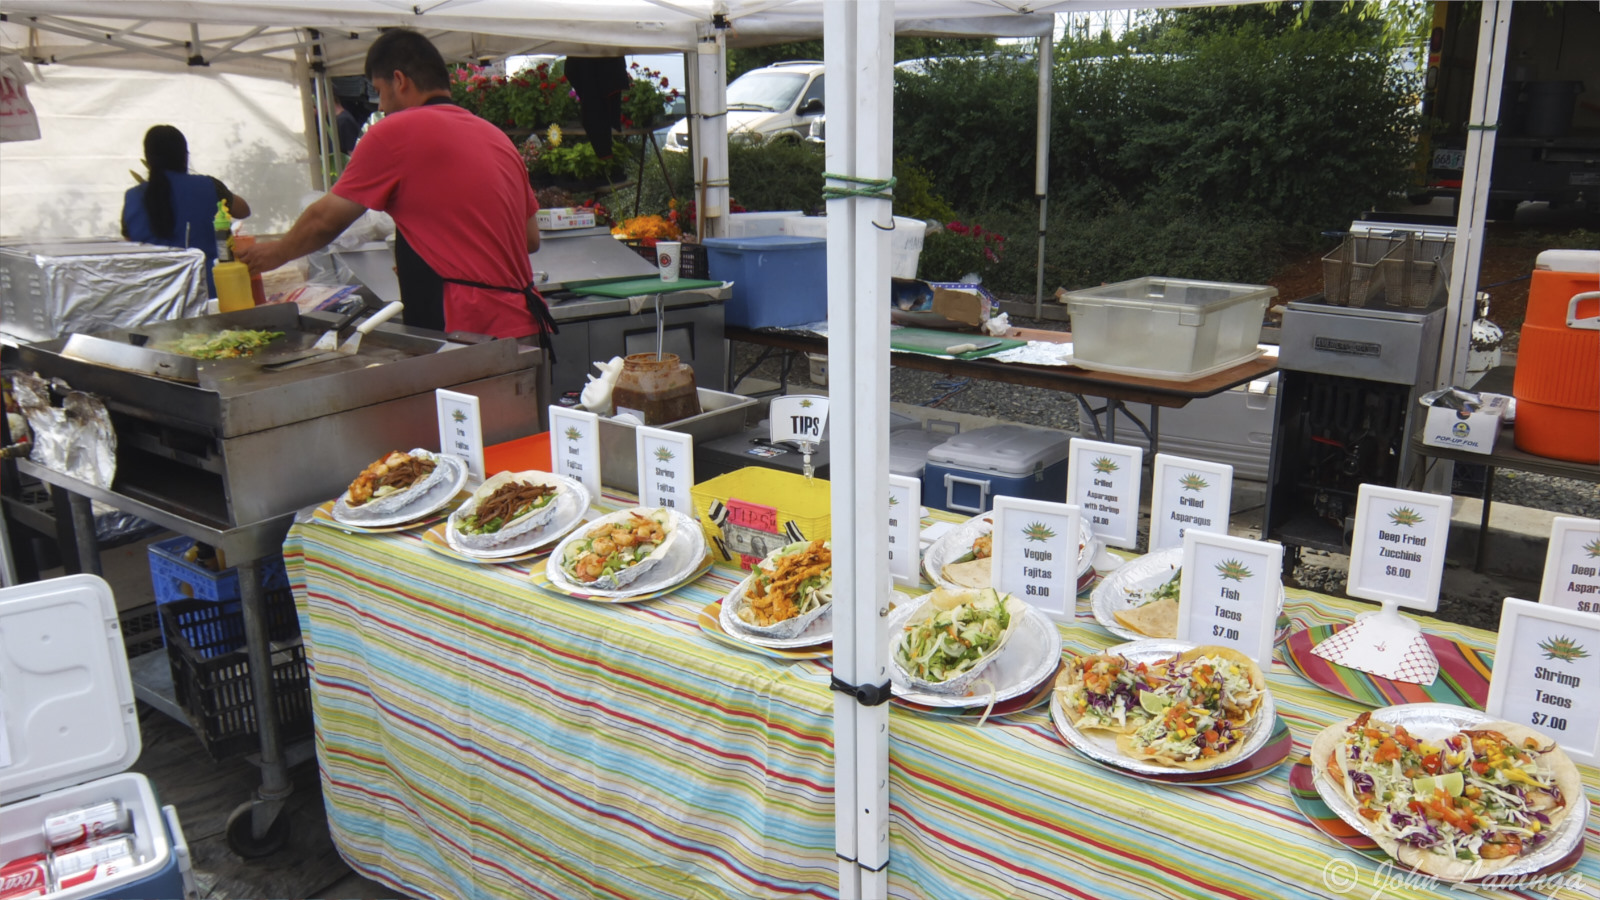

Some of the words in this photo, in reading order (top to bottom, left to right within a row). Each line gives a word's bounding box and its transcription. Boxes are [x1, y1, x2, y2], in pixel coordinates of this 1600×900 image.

[790, 415, 820, 436] TIPS
[656, 467, 675, 479] Shrimp
[657, 482, 675, 493] Fajitas
[1094, 478, 1112, 488] Grilled
[1087, 490, 1118, 502] Asparagus
[1180, 496, 1204, 508] Grilled
[1084, 502, 1098, 510] with
[1099, 504, 1120, 515] Shrimp
[1170, 511, 1211, 526] Asparagus
[1378, 530, 1400, 543] Deep
[1402, 534, 1427, 546] Fried
[1024, 548, 1052, 561] Veggie
[1380, 546, 1422, 562] Zucchinis
[1024, 566, 1052, 579] Fajitas
[1386, 565, 1411, 578] $6.00
[1571, 564, 1596, 577] Deep
[1026, 584, 1050, 597] $6.00
[1221, 587, 1240, 601] Fish
[1577, 601, 1600, 612] $6.0
[1215, 605, 1242, 622] Tacos
[1212, 625, 1240, 640] $7.00
[1534, 666, 1580, 688] Shrimp
[1536, 689, 1572, 709] Tacos
[1531, 712, 1567, 730] $7.00
